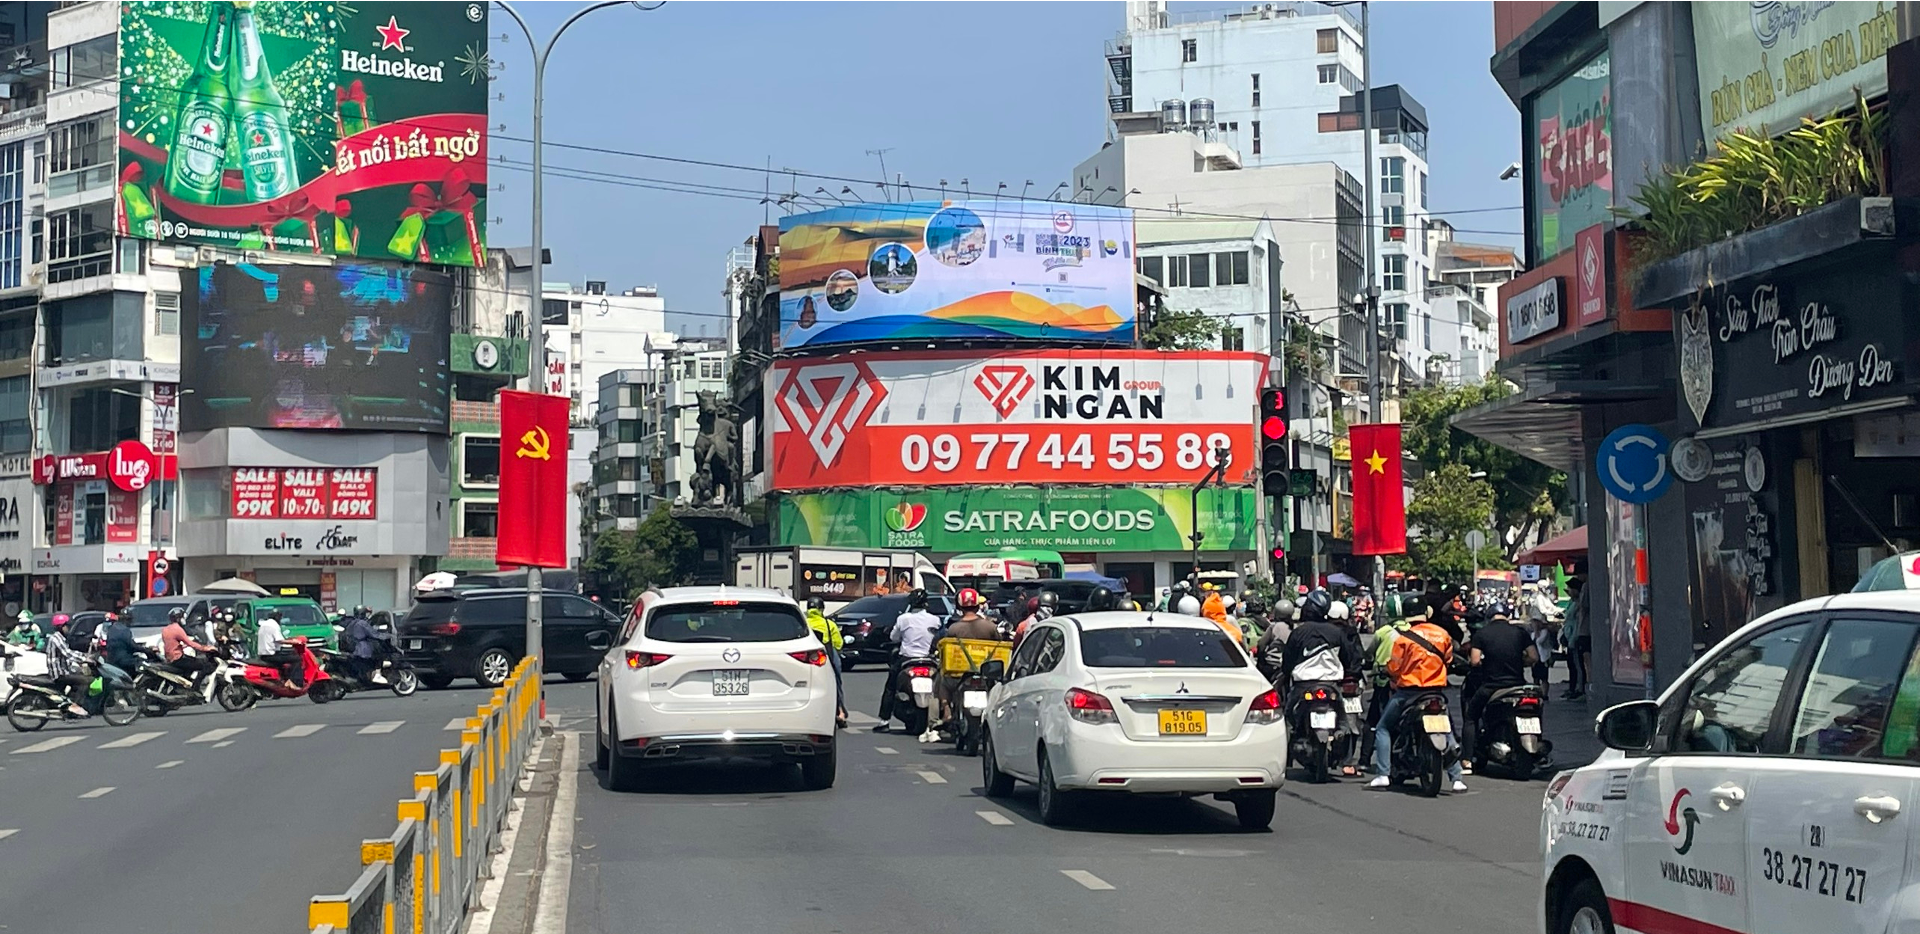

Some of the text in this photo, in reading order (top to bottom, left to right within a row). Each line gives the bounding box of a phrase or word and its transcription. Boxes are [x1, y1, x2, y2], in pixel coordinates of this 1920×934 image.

[341, 50, 444, 83] Heineken
[1711, 75, 1743, 127] BÚN
[1783, 46, 1818, 97] NEM
[1820, 30, 1858, 81] CUA
[179, 133, 225, 158] Heineken
[336, 127, 480, 176] ết nối bất ngờ
[1063, 235, 1090, 248] 2023
[1859, 343, 1893, 388] Đen
[1043, 365, 1120, 390] KIM
[1123, 380, 1162, 391] GROUP
[1044, 394, 1163, 420] NGAN
[900, 432, 1233, 473] 09 77 44 55 88
[115, 446, 150, 489] lug
[235, 468, 276, 483] SALE
[284, 469, 325, 487] SALE
[332, 468, 372, 483] SALE
[293, 488, 316, 498] VALI
[236, 499, 275, 516] 99K
[332, 499, 373, 516] 149K
[944, 509, 1155, 533] SATRAFOODS
[888, 531, 925, 540] SATRA
[888, 539, 926, 547] FOODS
[1172, 711, 1193, 721] 51G
[1763, 847, 1867, 904] 38.27 27 27
